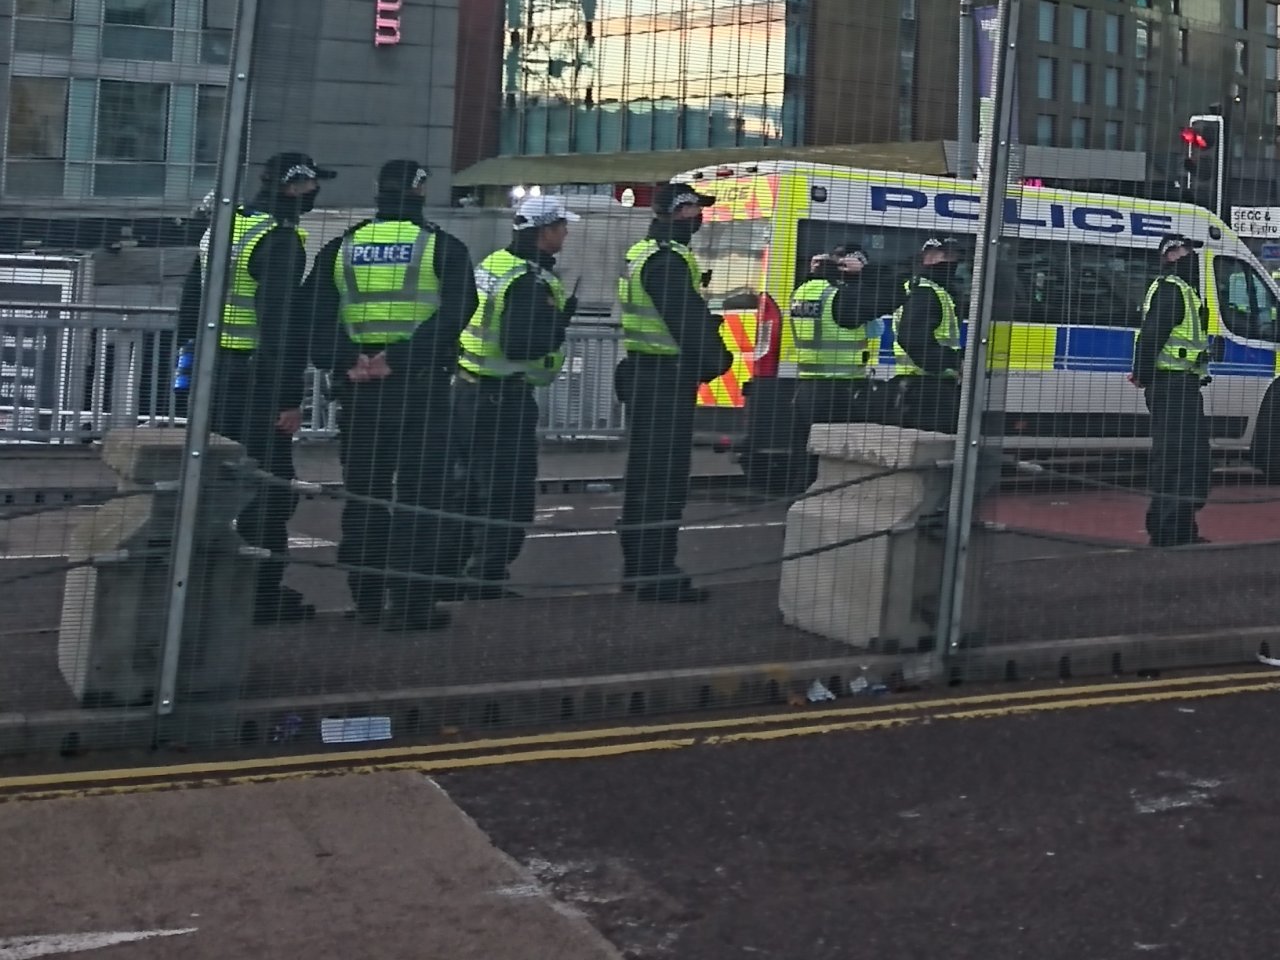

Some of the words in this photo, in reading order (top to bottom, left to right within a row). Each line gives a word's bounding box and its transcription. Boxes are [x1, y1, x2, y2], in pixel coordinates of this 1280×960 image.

[871, 186, 1172, 237] POLICE
[1234, 210, 1261, 220] SECC
[353, 244, 411, 261] POLICE
